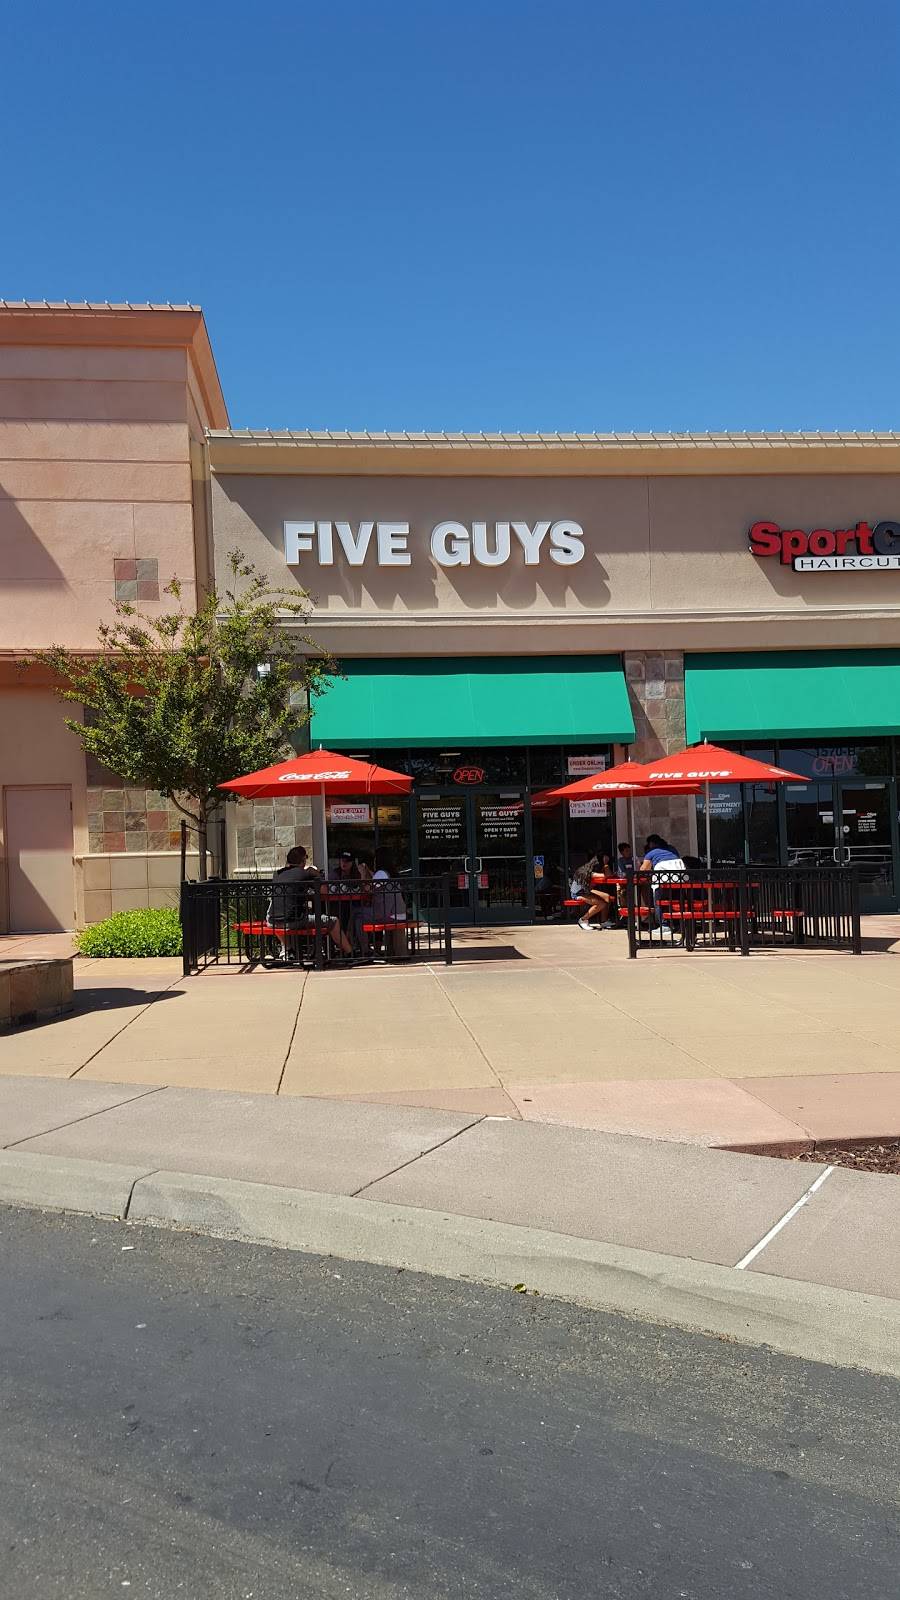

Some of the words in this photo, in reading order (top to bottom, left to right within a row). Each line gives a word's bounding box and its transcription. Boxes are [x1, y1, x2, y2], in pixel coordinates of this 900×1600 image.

[283, 520, 412, 567] FIVE
[430, 519, 586, 568] GUYS
[812, 757, 853, 772] OPEN
[278, 771, 352, 781] Coca-Cola
[453, 768, 485, 782] OPEN
